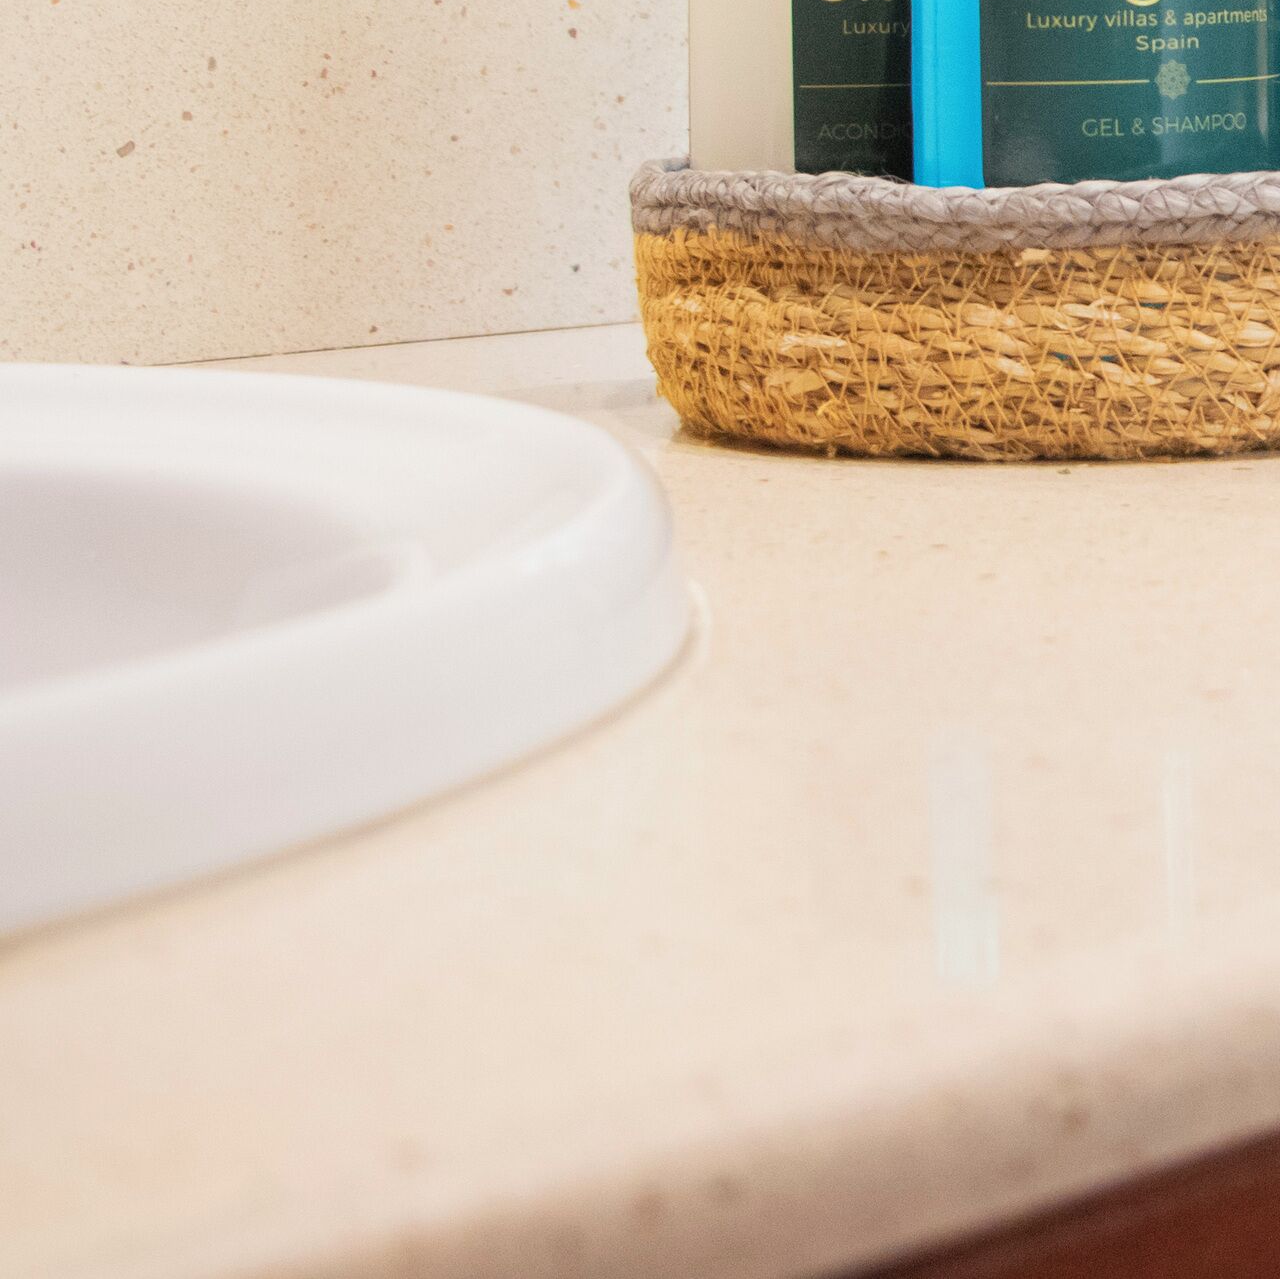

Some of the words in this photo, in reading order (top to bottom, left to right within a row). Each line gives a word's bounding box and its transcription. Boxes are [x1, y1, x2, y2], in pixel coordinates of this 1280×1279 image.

[1026, 12, 1098, 32] Luxury
[1104, 10, 1158, 27] villas
[1164, 9, 1178, 26] &
[1183, 8, 1268, 29] apartments
[1135, 34, 1200, 54] Spain
[1081, 118, 1125, 137] GEL
[1131, 117, 1146, 136] &
[1151, 112, 1247, 135] SHAMPOO
